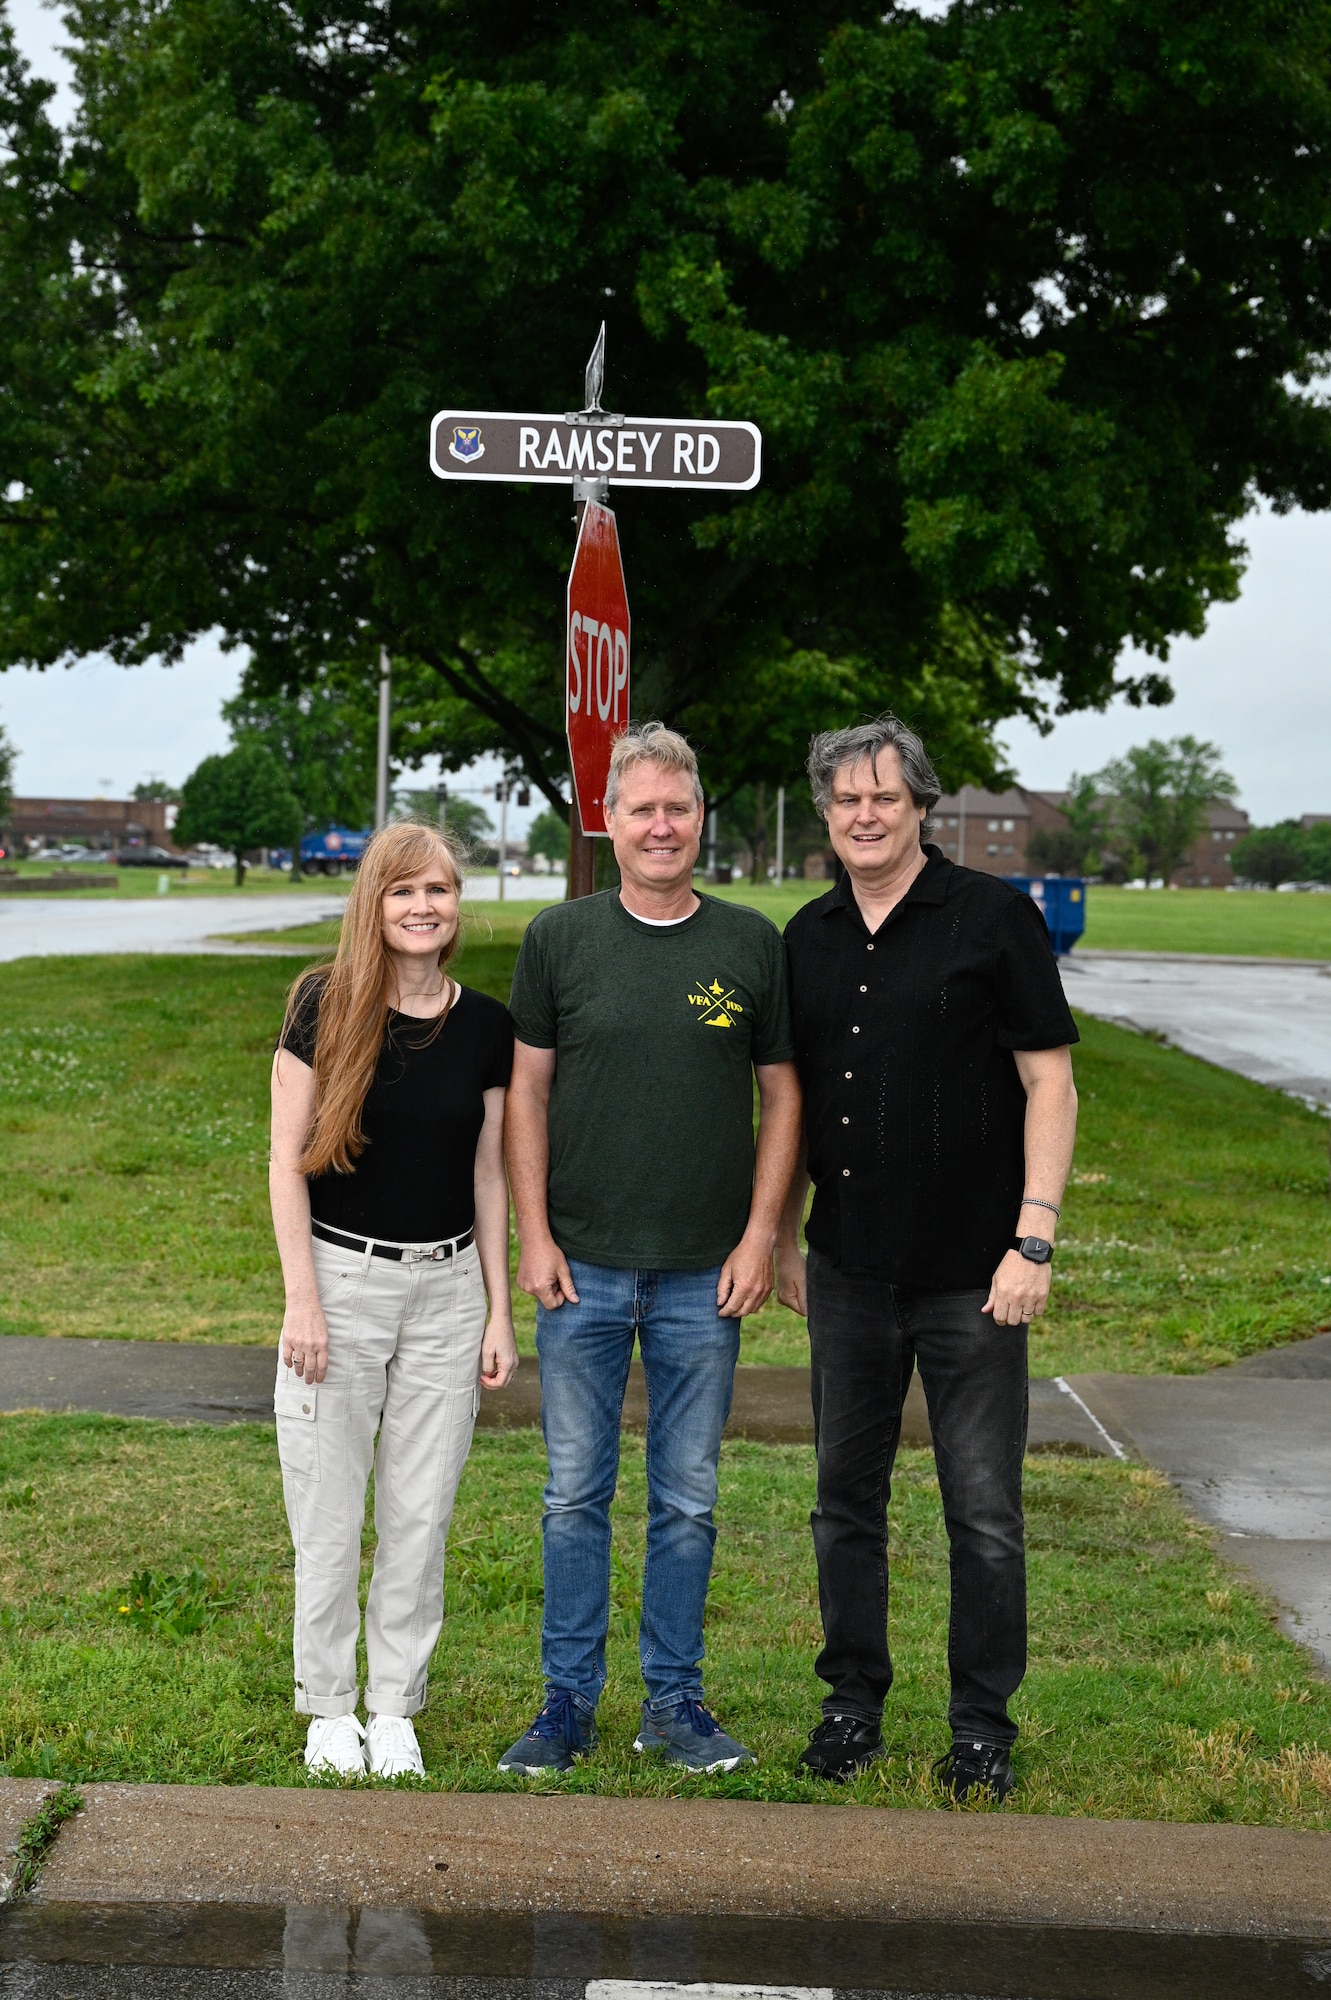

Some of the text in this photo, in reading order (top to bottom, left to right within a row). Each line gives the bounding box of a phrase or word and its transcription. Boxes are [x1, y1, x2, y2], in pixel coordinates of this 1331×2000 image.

[519, 427, 721, 474] RAMSEY RD
[569, 609, 628, 724] STOP
